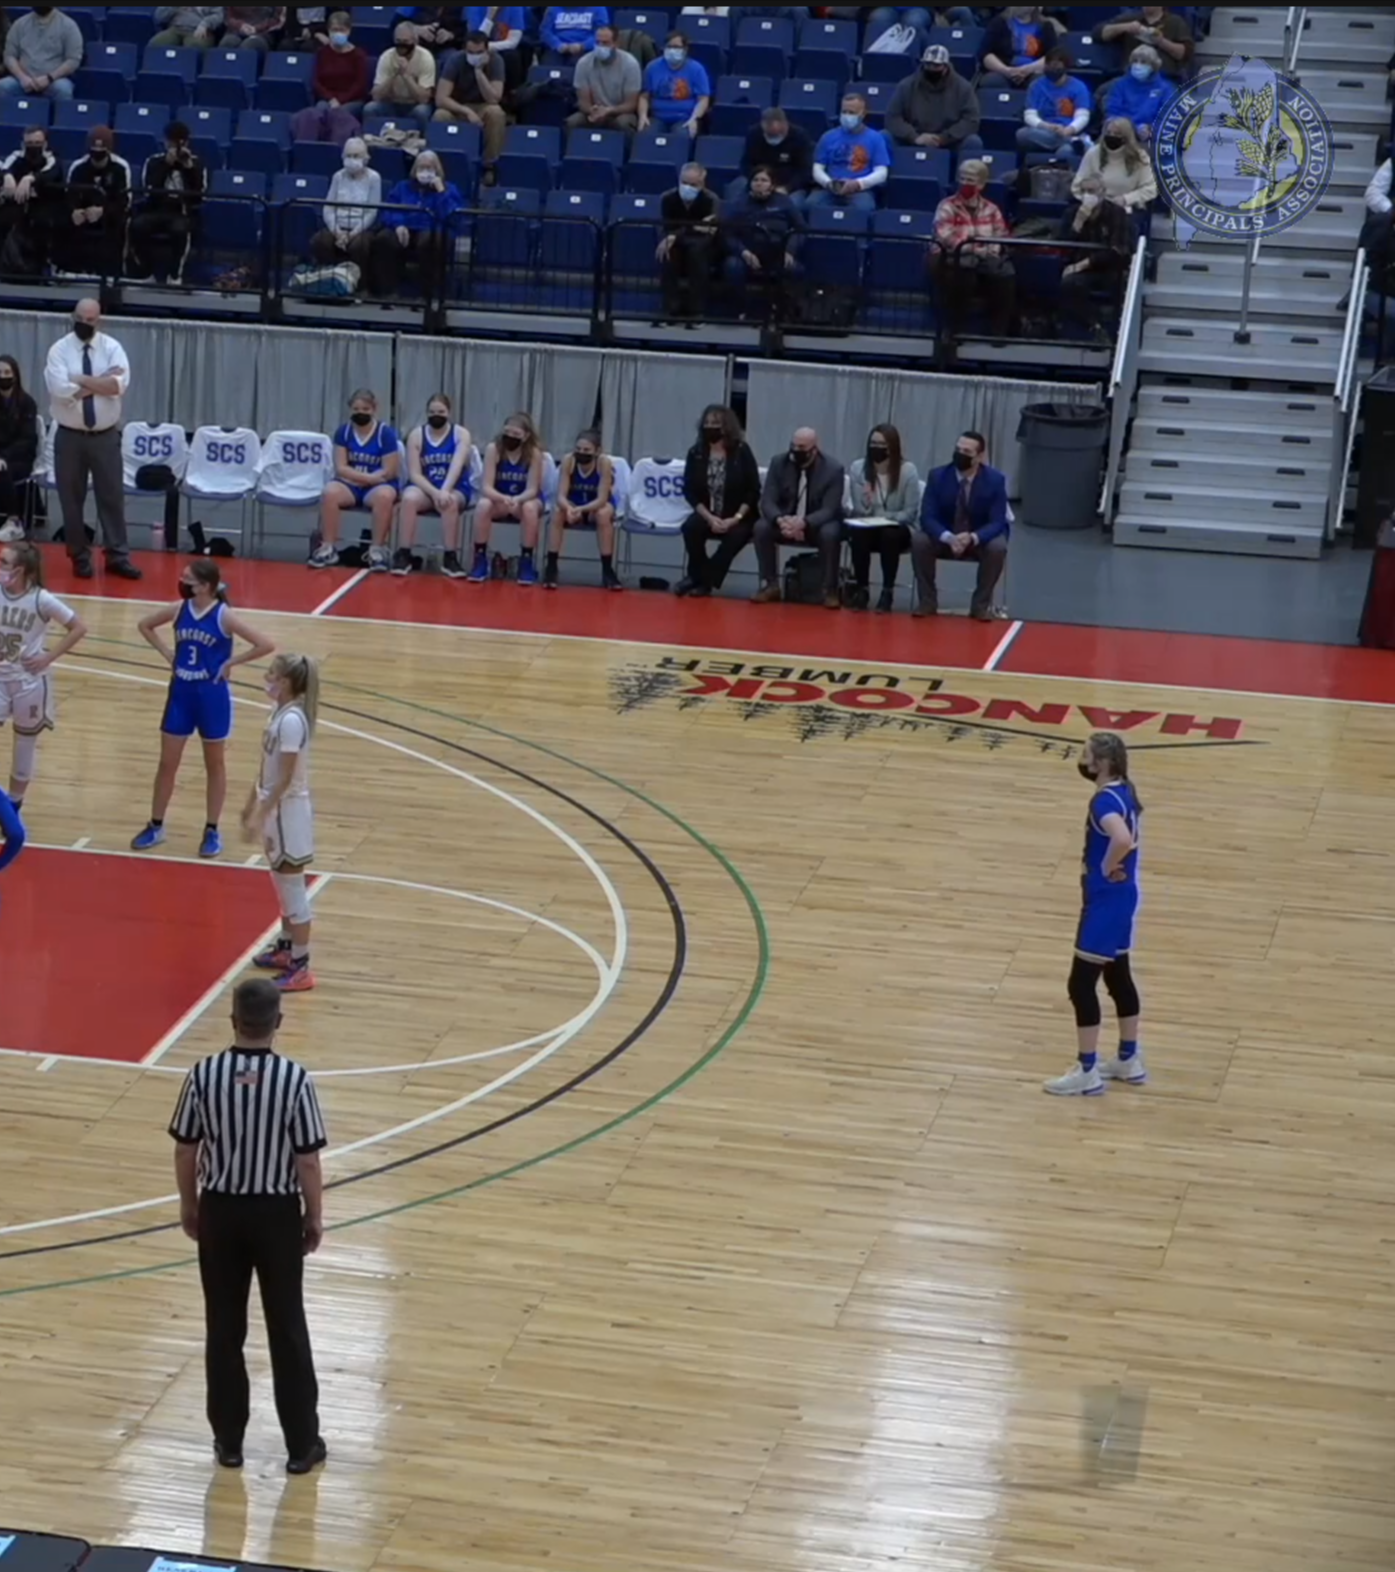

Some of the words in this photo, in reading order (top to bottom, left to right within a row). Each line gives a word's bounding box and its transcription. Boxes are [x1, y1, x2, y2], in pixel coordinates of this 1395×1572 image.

[134, 435, 173, 457] SCS
[206, 441, 246, 464] SCS
[283, 442, 323, 464] SCS
[643, 476, 685, 498] SCS
[187, 645, 197, 666] 3
[655, 656, 943, 691] LUMBER
[677, 673, 1243, 740] HANCOCK
